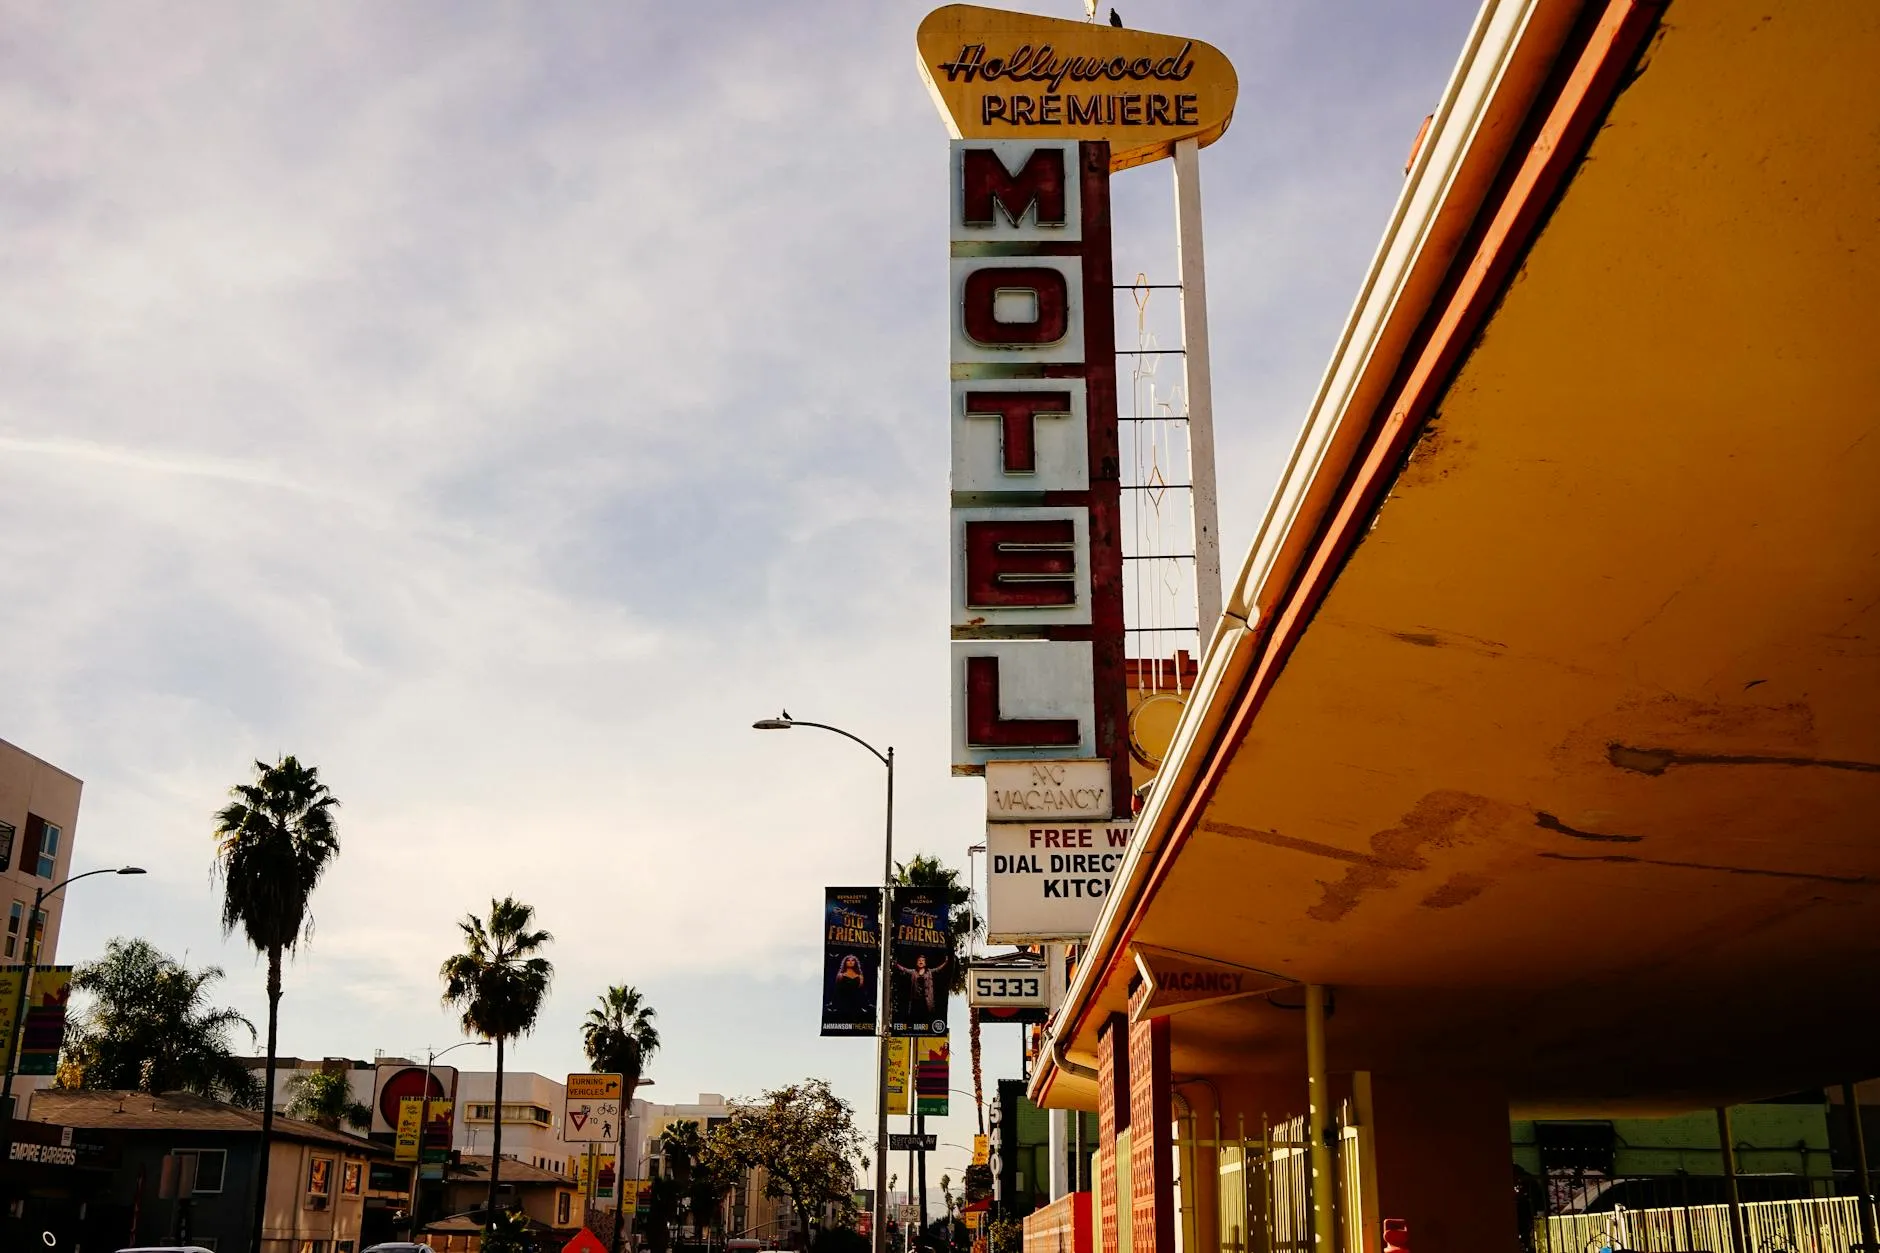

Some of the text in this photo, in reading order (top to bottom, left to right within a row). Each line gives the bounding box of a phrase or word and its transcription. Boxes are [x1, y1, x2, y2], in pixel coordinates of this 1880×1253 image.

[938, 41, 1197, 93] Hollywood
[982, 94, 1199, 125] PREMIERE
[962, 147, 1083, 750] MOTEL
[994, 788, 1104, 812] VACANCY
[1029, 829, 1093, 848] FREE
[994, 855, 1043, 874] DIAL
[828, 925, 875, 944] FRIENDS
[898, 925, 946, 944] FRIENDS
[977, 978, 1039, 997] 5333
[1155, 971, 1244, 992] VACANCY
[571, 1078, 604, 1086] TURNING
[569, 1088, 605, 1096] VEHICLES
[589, 1117, 599, 1125] TO
[9, 1142, 77, 1166] EMPIRE BARBERS
